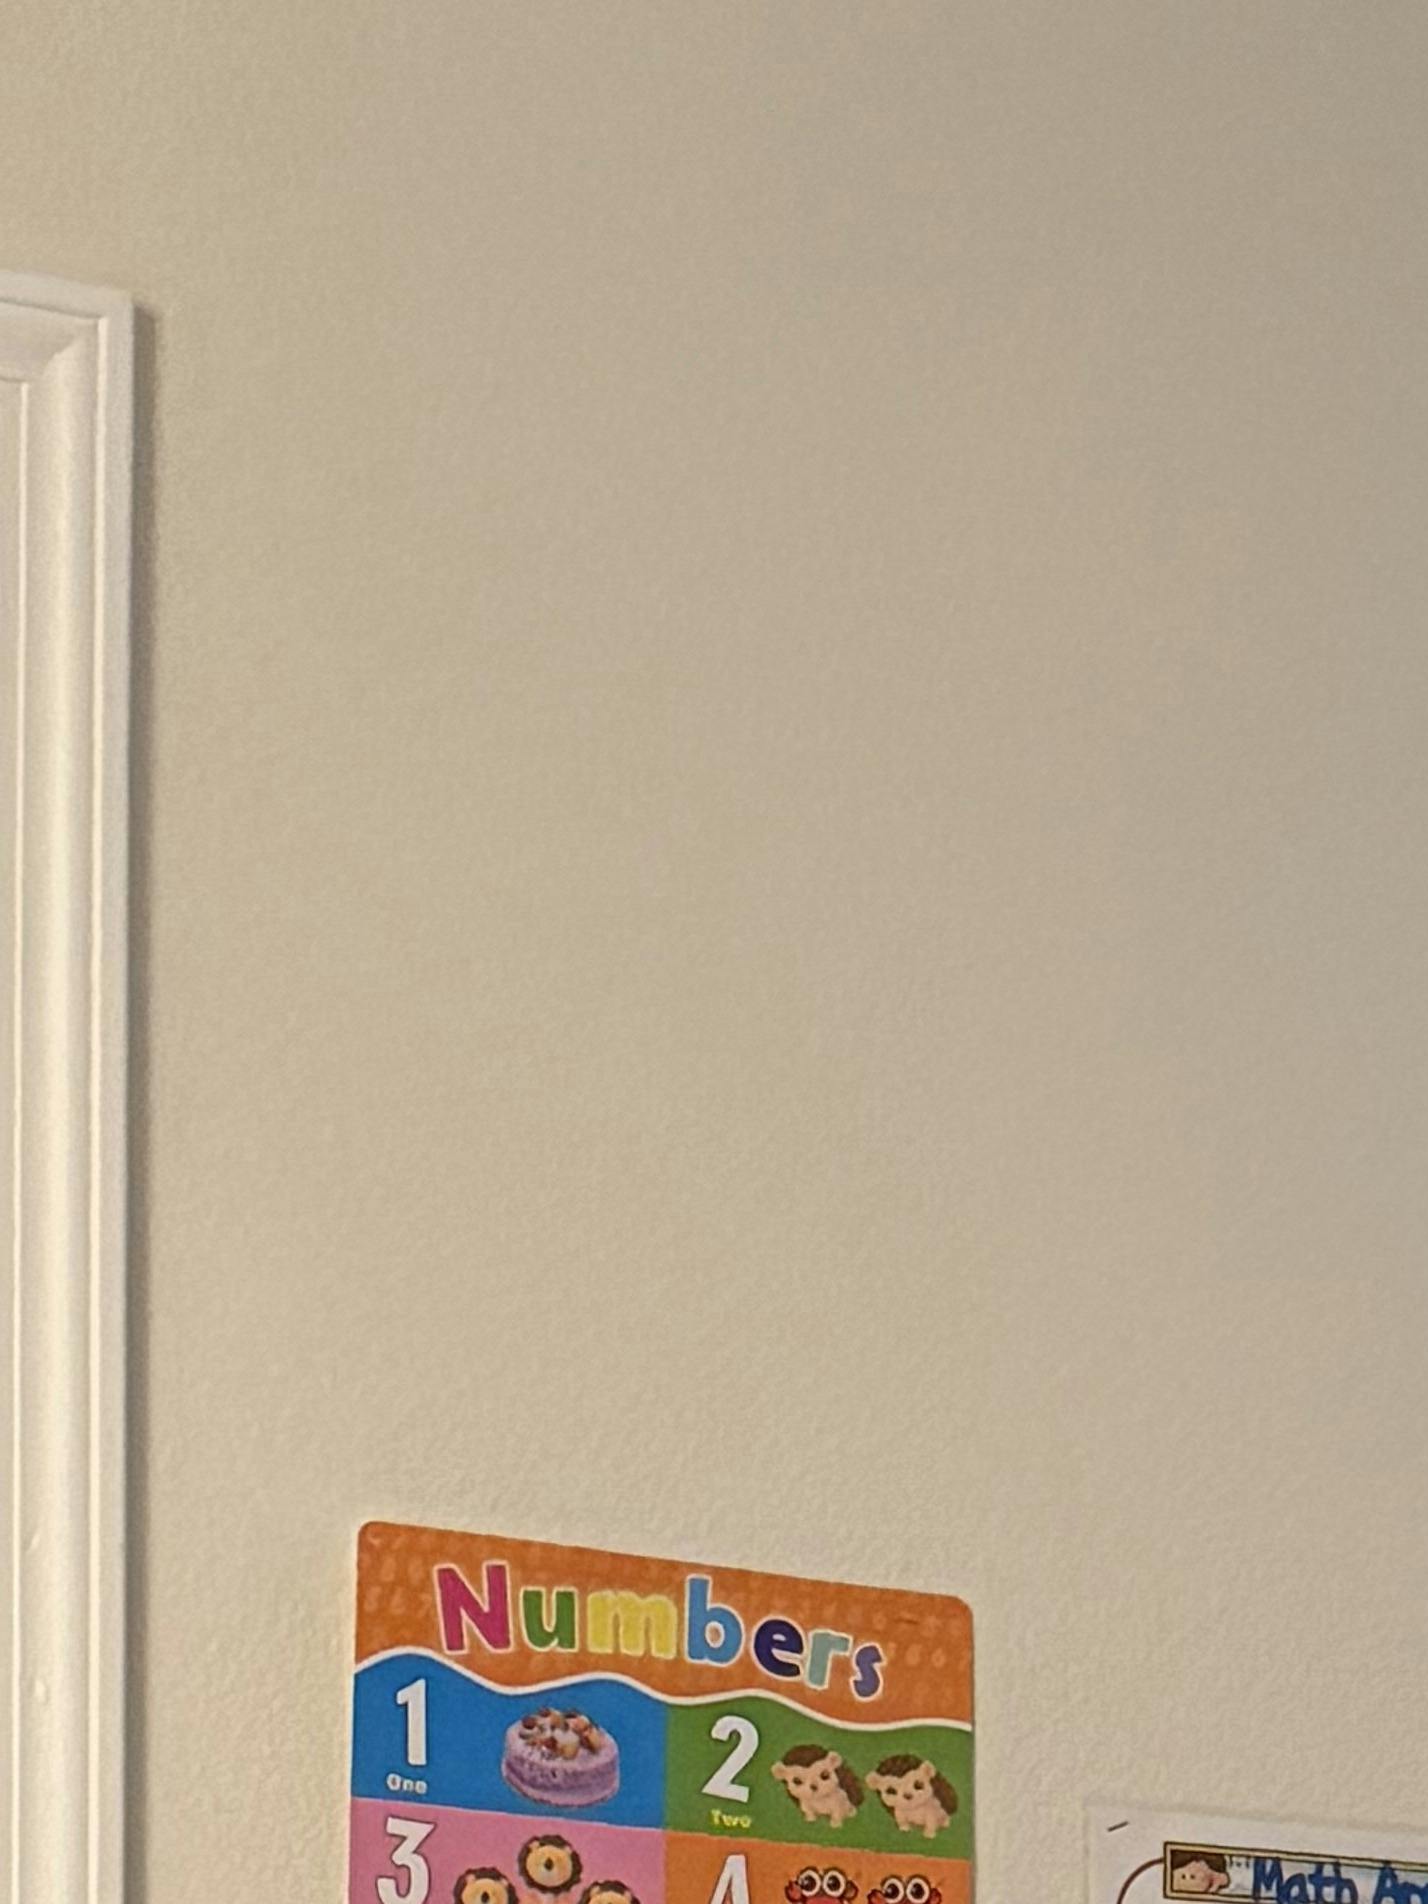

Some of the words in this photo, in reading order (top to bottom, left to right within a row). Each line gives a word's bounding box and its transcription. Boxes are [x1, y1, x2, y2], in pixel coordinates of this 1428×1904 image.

[434, 1562, 885, 1699] Numbers
[396, 1678, 428, 1767] 1
[701, 1715, 760, 1803] 2
[387, 1773, 428, 1796] One
[710, 1809, 751, 1830] Two
